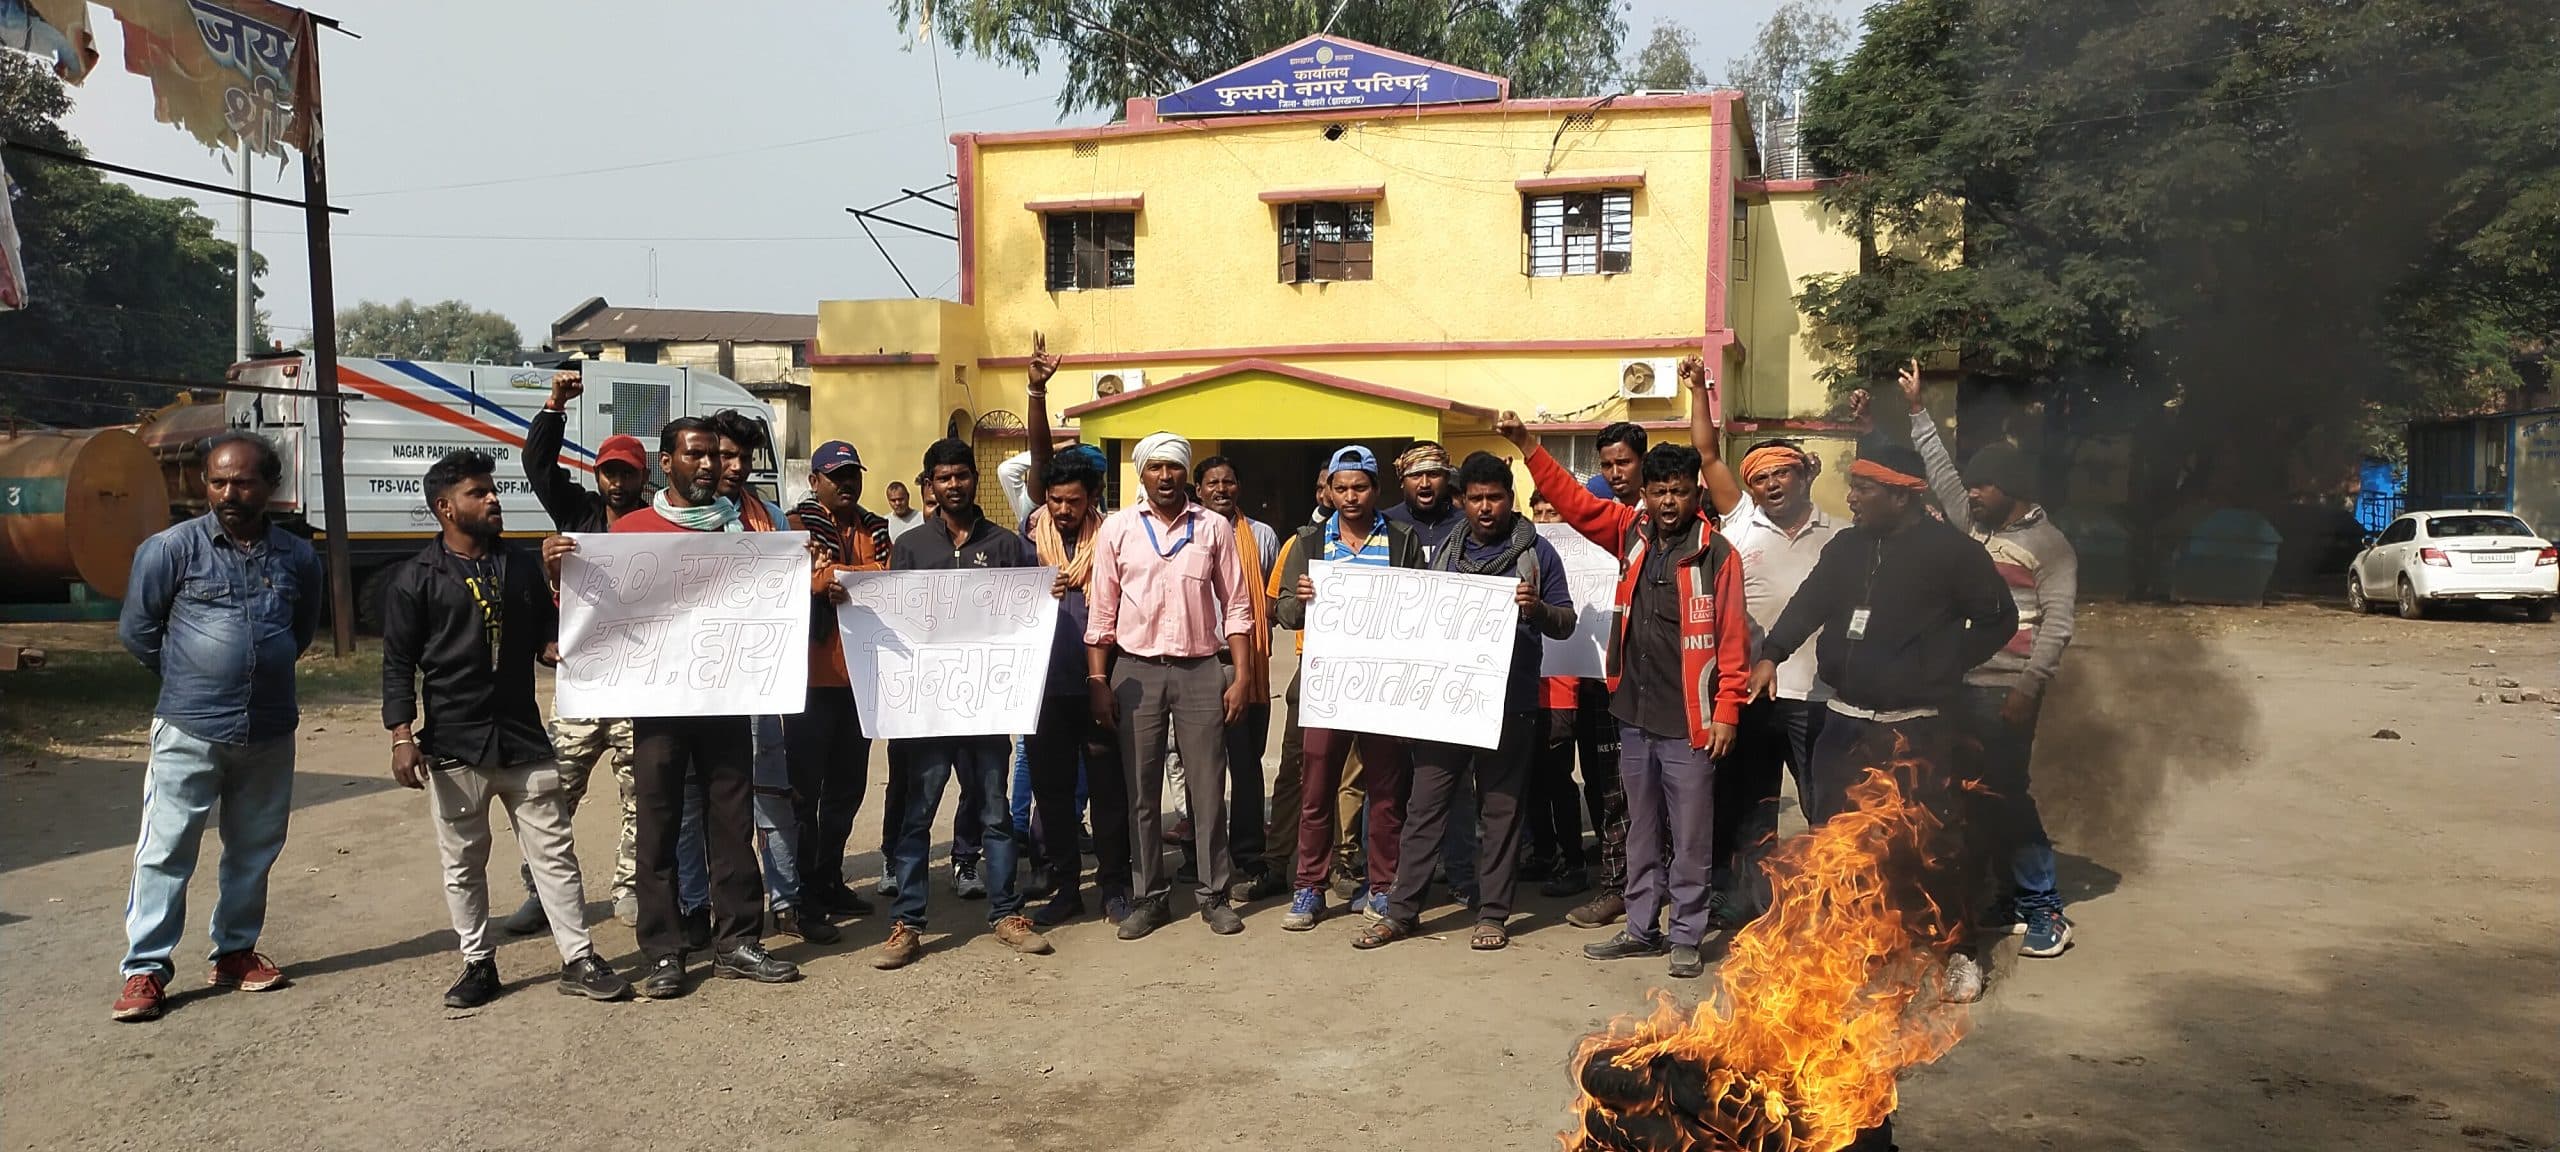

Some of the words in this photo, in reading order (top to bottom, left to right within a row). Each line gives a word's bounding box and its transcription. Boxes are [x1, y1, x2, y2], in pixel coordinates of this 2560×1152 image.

[187, 0, 296, 78] जय
[1214, 79, 1289, 107] फुसरो
[1293, 80, 1348, 97] नगर
[1293, 64, 1350, 81] कार्यालय
[392, 444, 425, 459] NAGAR
[369, 479, 420, 493] TPS-VAC
[1312, 566, 1441, 640] हमारा
[688, 618, 798, 696] हाय
[1306, 656, 1449, 719] भुगतान
